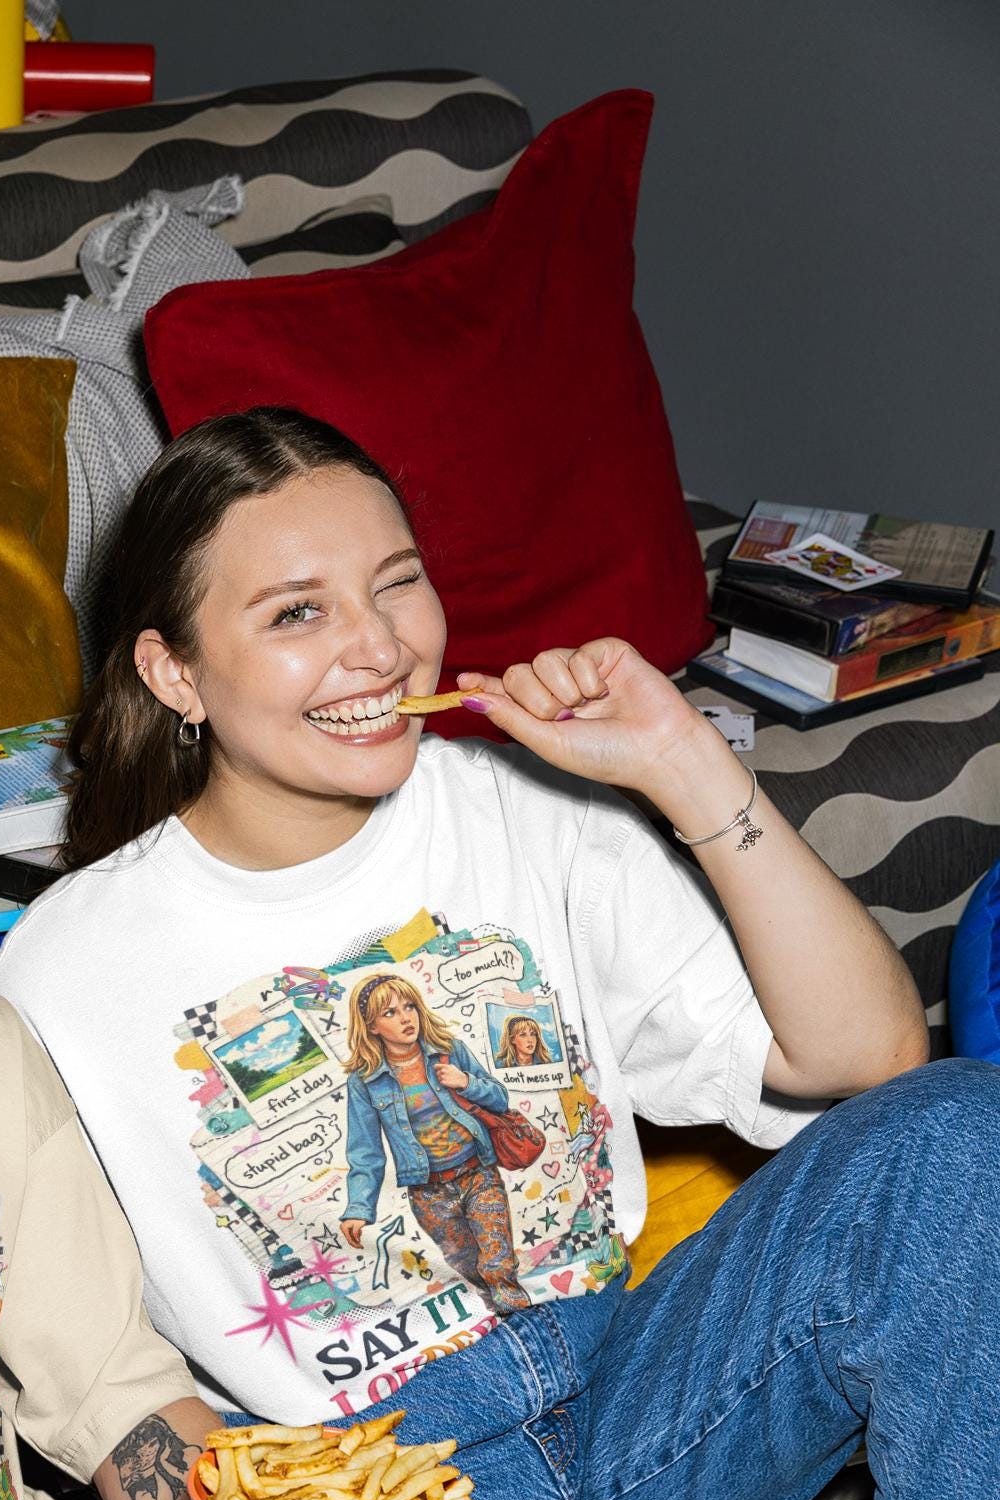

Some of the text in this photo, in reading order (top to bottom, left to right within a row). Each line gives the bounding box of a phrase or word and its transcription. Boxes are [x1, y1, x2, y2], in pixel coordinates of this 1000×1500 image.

[474, 950, 515, 975] much??
[267, 1073, 333, 1113] first day
[503, 1071, 564, 1085] don't mess up
[243, 1124, 328, 1180] stupid bag?
[315, 1282, 473, 1385] SAY IT
